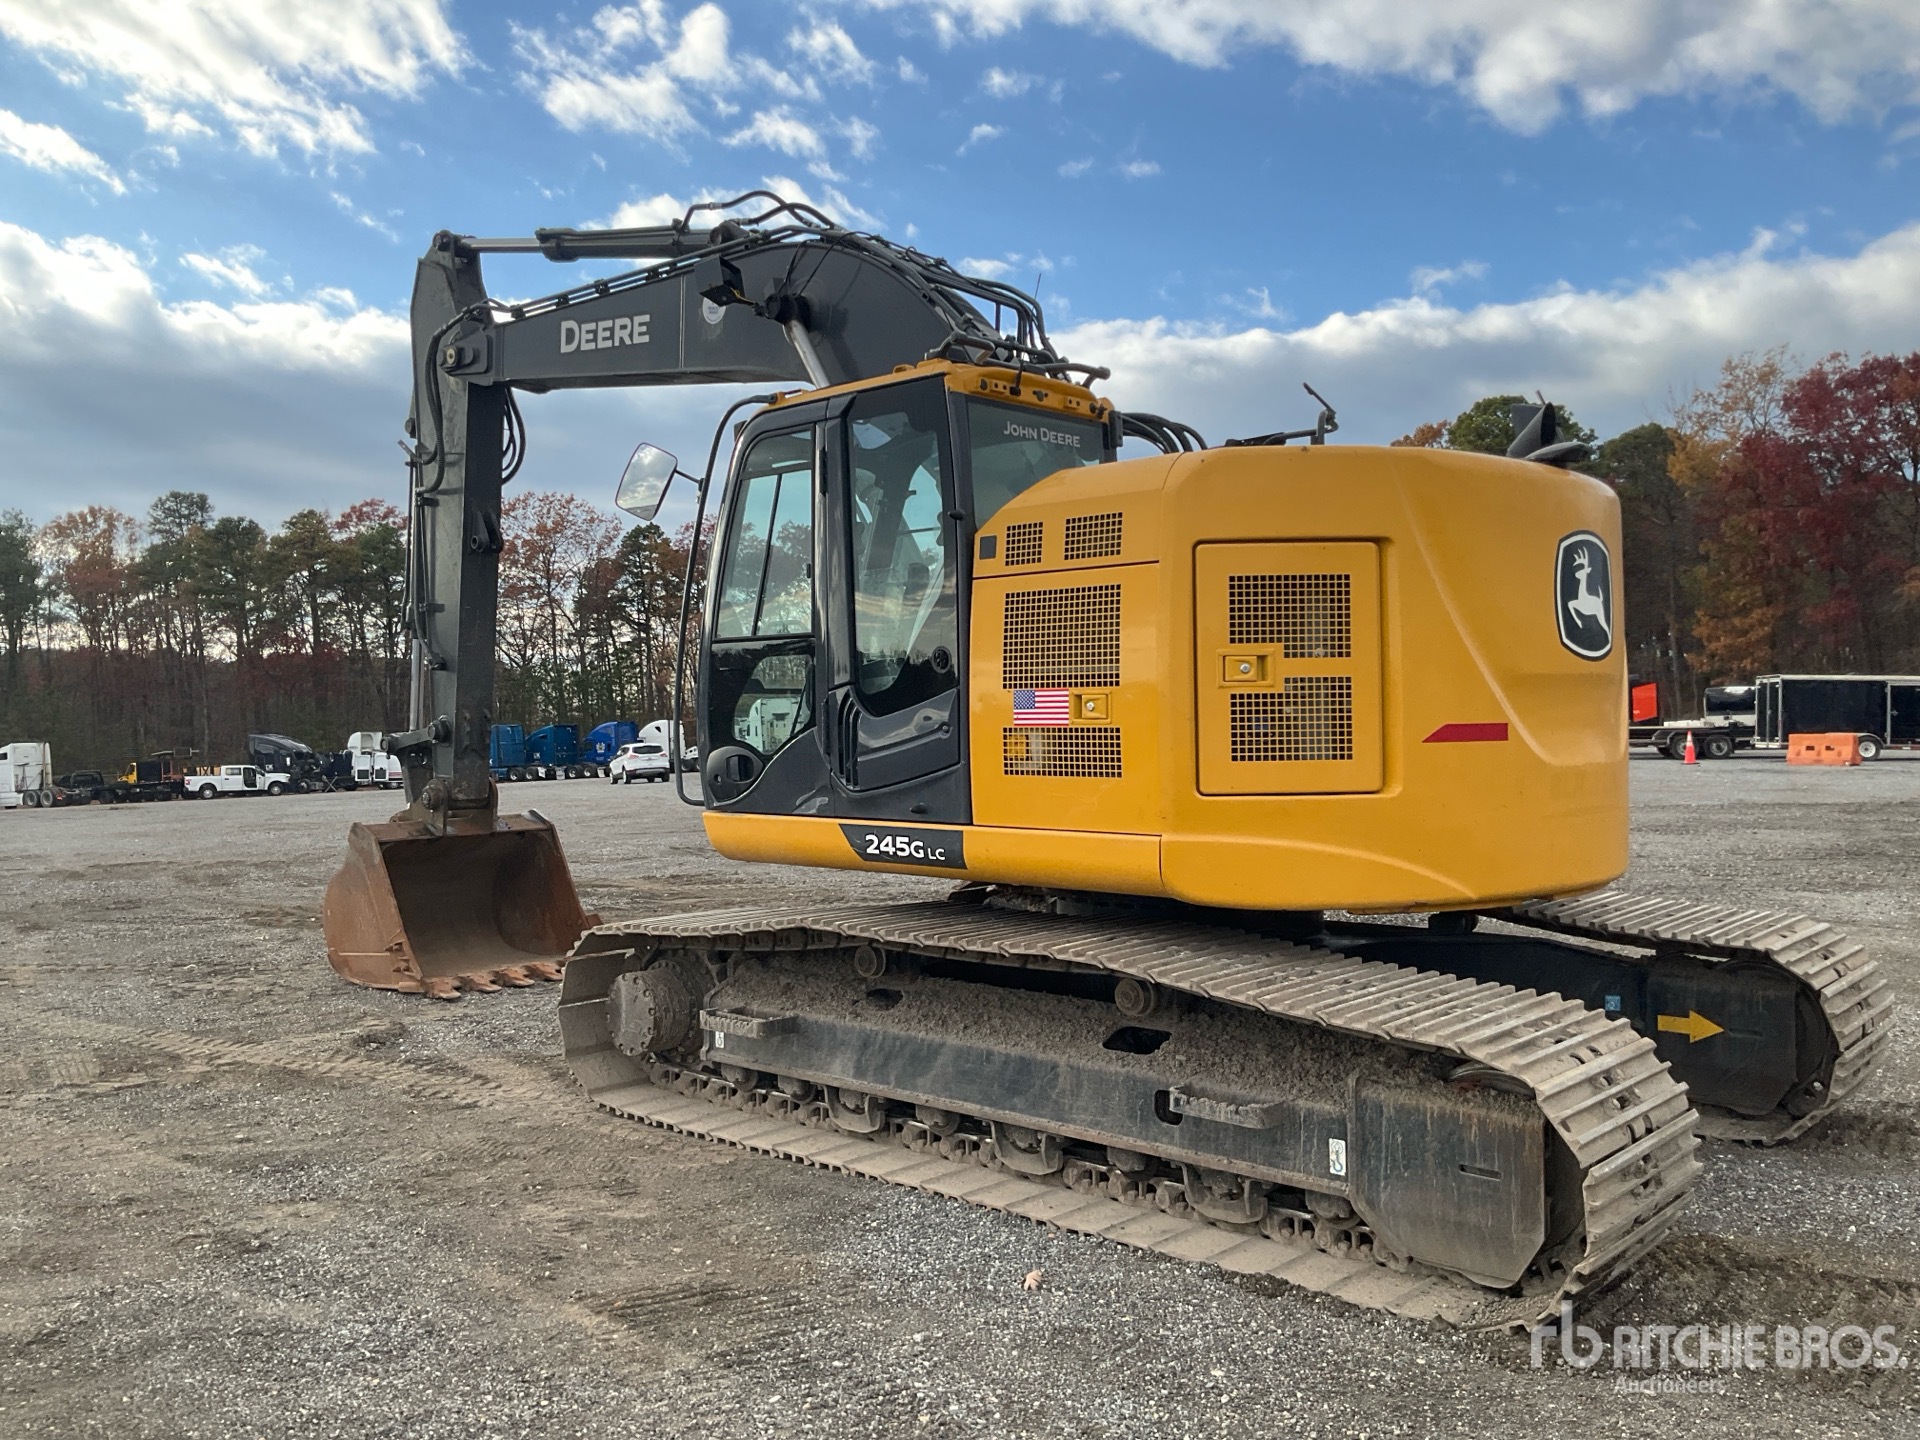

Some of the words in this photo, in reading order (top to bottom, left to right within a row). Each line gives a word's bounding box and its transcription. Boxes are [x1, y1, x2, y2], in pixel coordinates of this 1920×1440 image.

[560, 314, 651, 353] DEERE
[1003, 421, 1038, 440] JOHN
[1040, 427, 1081, 448] DEERE
[865, 834, 925, 858] 245G
[927, 847, 946, 861] LC
